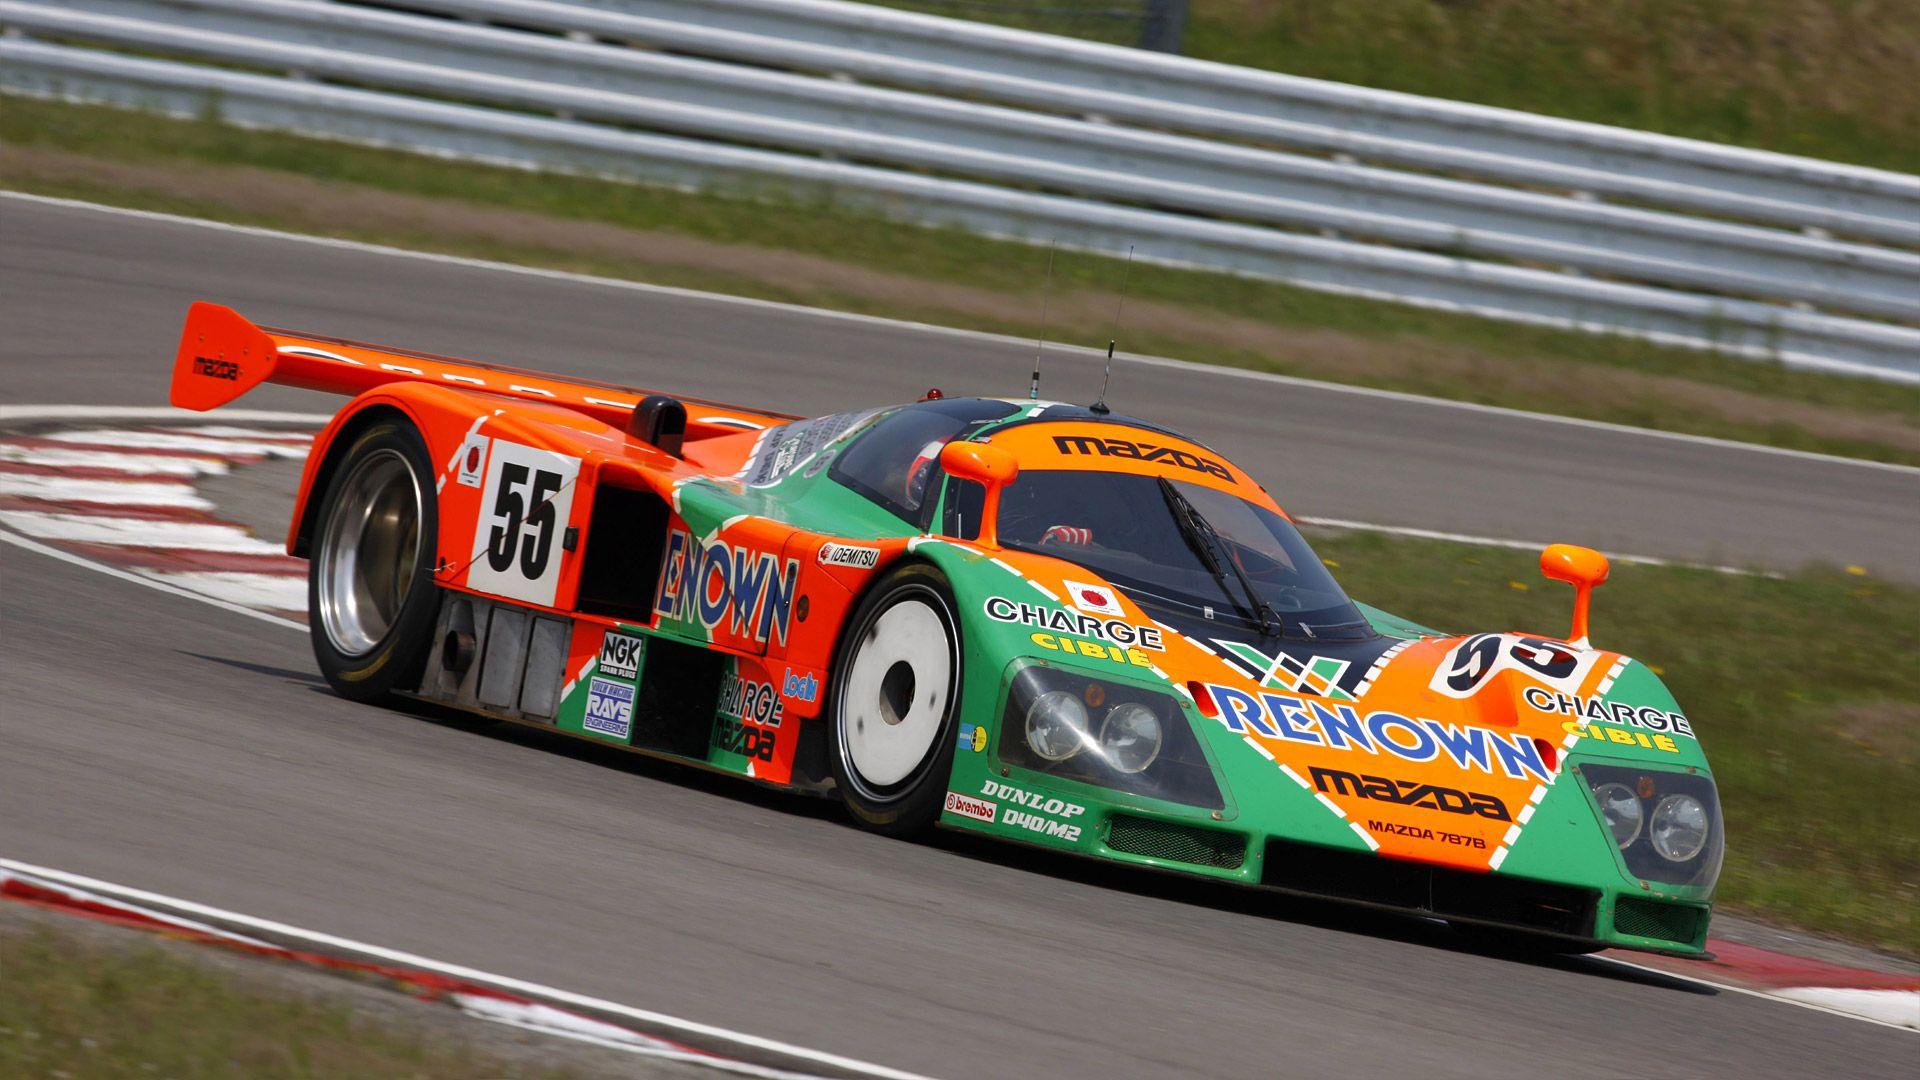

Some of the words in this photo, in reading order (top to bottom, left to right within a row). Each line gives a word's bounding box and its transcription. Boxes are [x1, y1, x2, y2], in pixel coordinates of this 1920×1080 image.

[192, 357, 238, 381] mazda
[1052, 436, 1239, 485] mazda
[487, 461, 563, 581] 55
[831, 547, 879, 567] IDEMITSU
[653, 528, 801, 648] ENOWN
[984, 595, 1167, 653] CHARGE
[602, 635, 640, 668] NGK
[585, 716, 629, 734] ENGINEERING
[590, 695, 631, 722] RAYS
[1522, 686, 1697, 741] CHARGE
[1204, 682, 1556, 786] RENOWN
[955, 796, 994, 819] brembo
[980, 780, 1086, 818] DUNLOP
[1307, 765, 1514, 823] mazda
[1002, 808, 1082, 842] D40/M2
[1368, 819, 1435, 841] MAZDA
[1436, 831, 1487, 850] 787B
